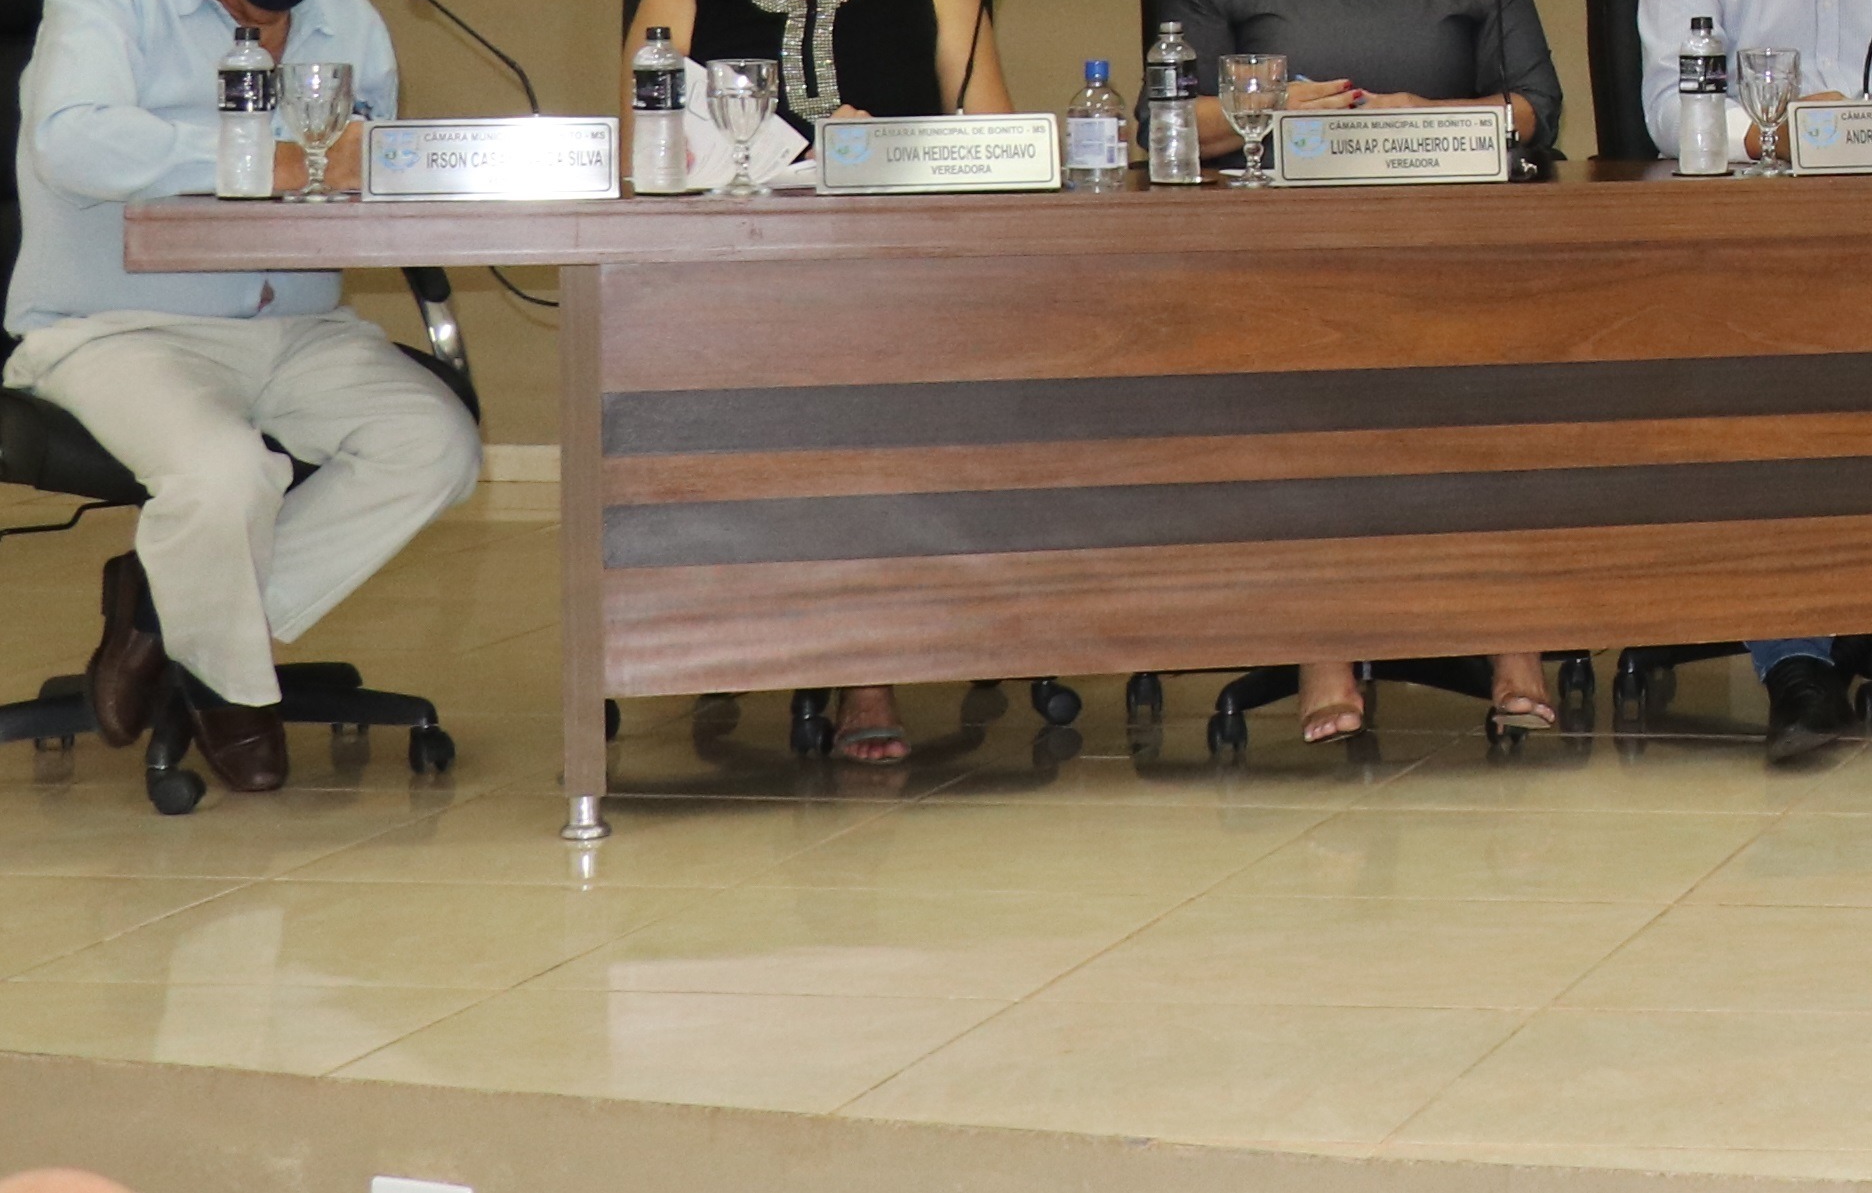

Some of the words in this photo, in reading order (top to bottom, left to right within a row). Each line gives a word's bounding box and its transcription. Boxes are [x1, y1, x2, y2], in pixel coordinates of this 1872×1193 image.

[1372, 121, 1419, 129] MUNICIPAL
[1423, 120, 1435, 128] DE
[1438, 120, 1472, 128] BONITO
[1480, 119, 1493, 127] MS
[591, 131, 605, 140] MS
[919, 127, 968, 136] MUNICIPAL
[972, 127, 985, 135] DE
[988, 126, 1024, 134] BONITO
[1331, 138, 1362, 154] LUISA
[1384, 137, 1449, 152] CAVALHEIRO
[1453, 136, 1465, 151] DE
[1470, 136, 1494, 151] LIMA
[887, 146, 921, 162] LOIVA
[923, 144, 981, 160] HEIDECKE
[986, 144, 1036, 159] SCHIAVO
[426, 152, 467, 168] IRSON
[569, 151, 603, 166] SILVA
[1387, 158, 1440, 168] VEREADORA
[931, 164, 991, 175] VEREADORA
